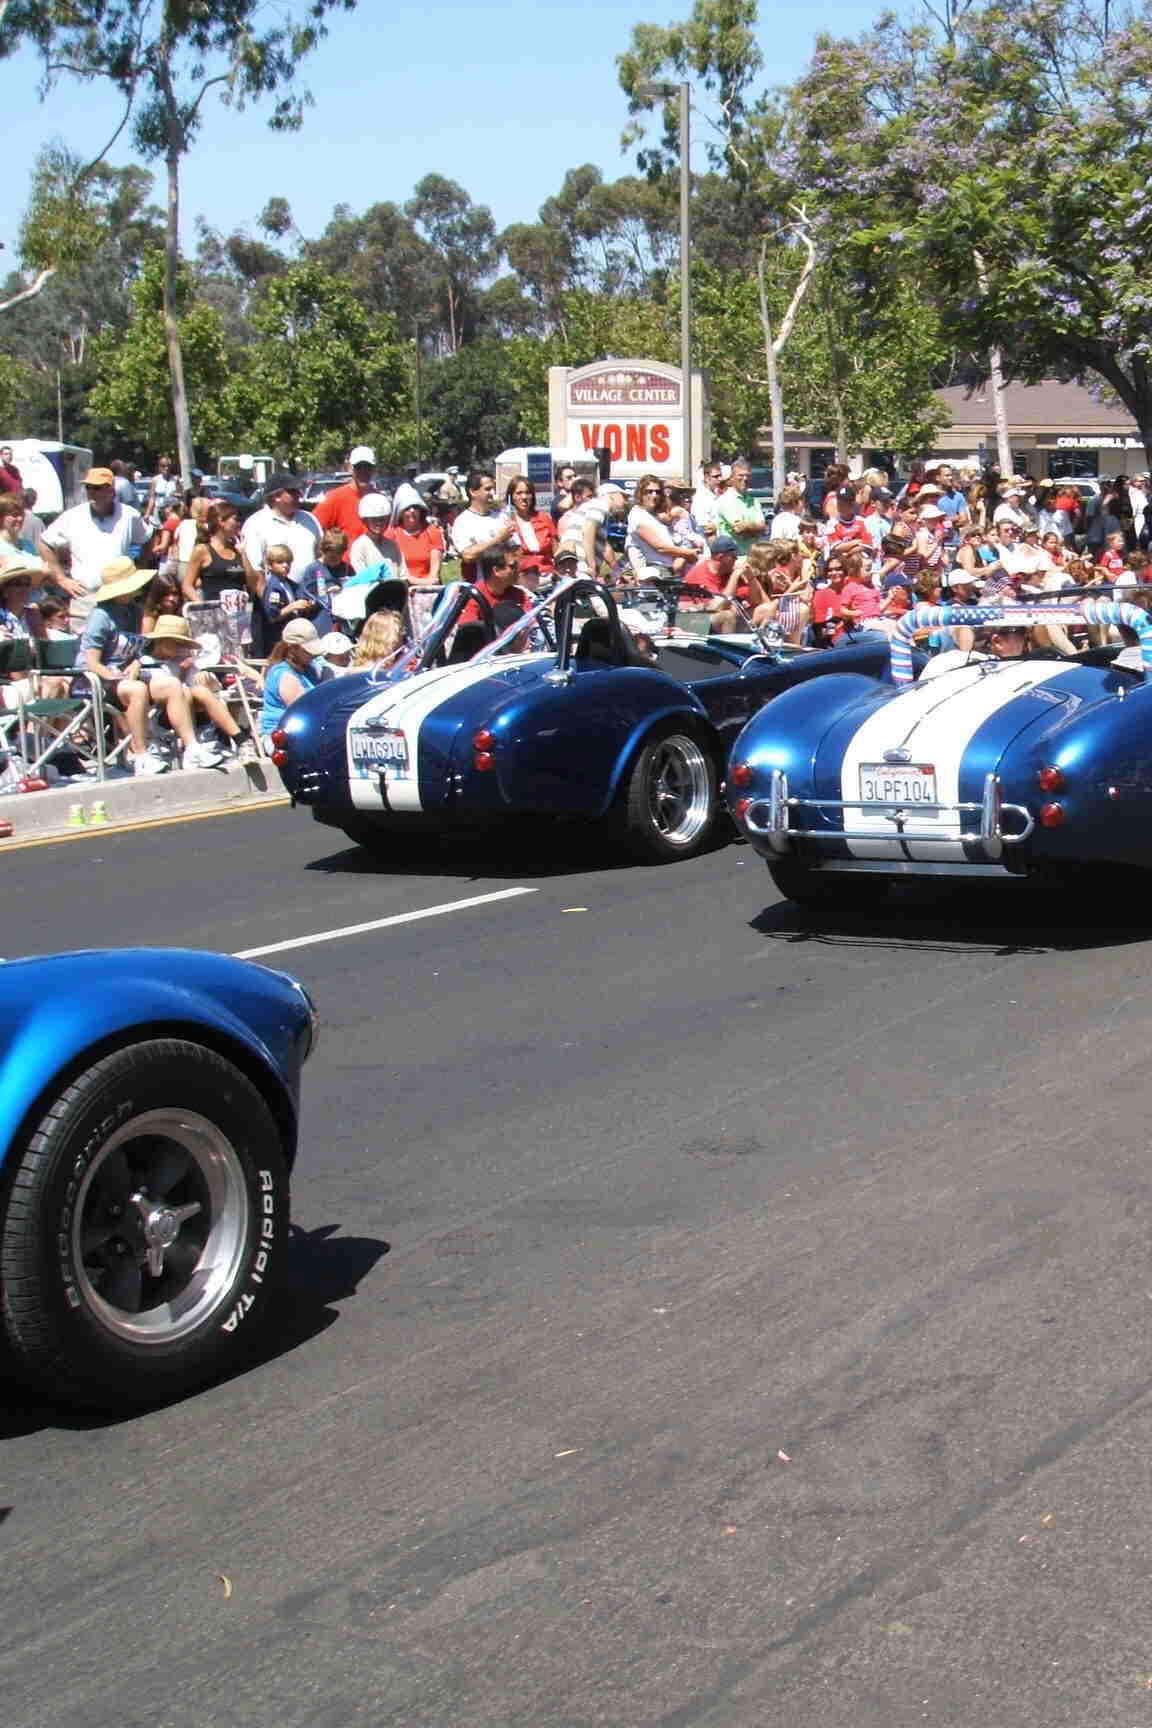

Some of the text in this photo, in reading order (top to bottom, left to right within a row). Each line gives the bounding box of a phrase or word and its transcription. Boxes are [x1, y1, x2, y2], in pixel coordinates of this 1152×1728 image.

[575, 389, 676, 401] VILLAGE CENTER
[580, 423, 670, 463] VONS
[865, 780, 931, 801] 3LPF104
[221, 1293, 255, 1332] T/A
